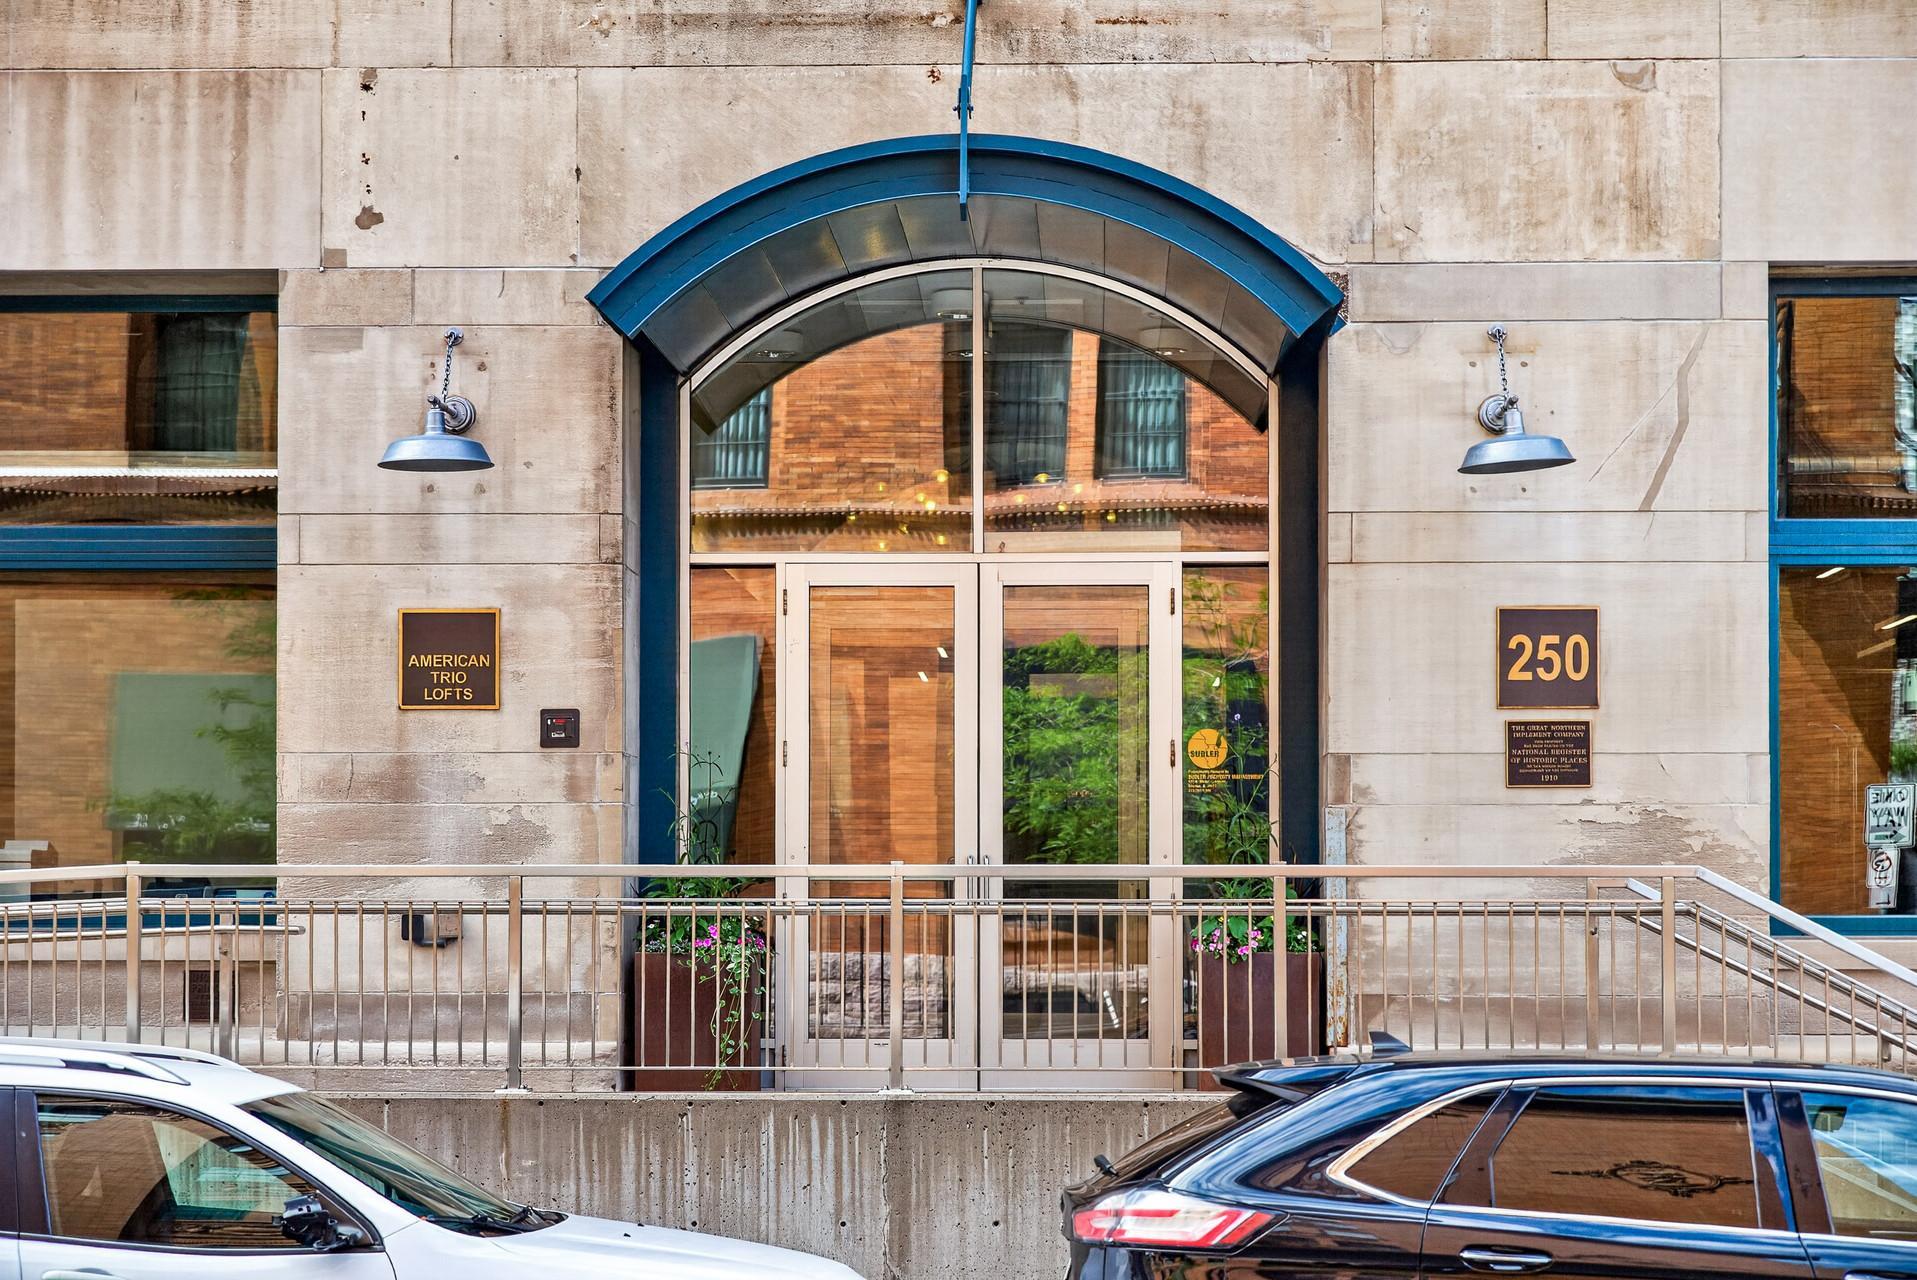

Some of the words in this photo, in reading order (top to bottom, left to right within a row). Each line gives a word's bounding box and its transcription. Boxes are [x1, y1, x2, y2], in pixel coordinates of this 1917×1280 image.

[408, 654, 490, 667] AMERICAN
[1507, 634, 1590, 681] 250
[430, 671, 467, 684] TRIO
[424, 688, 473, 700] LOFTS
